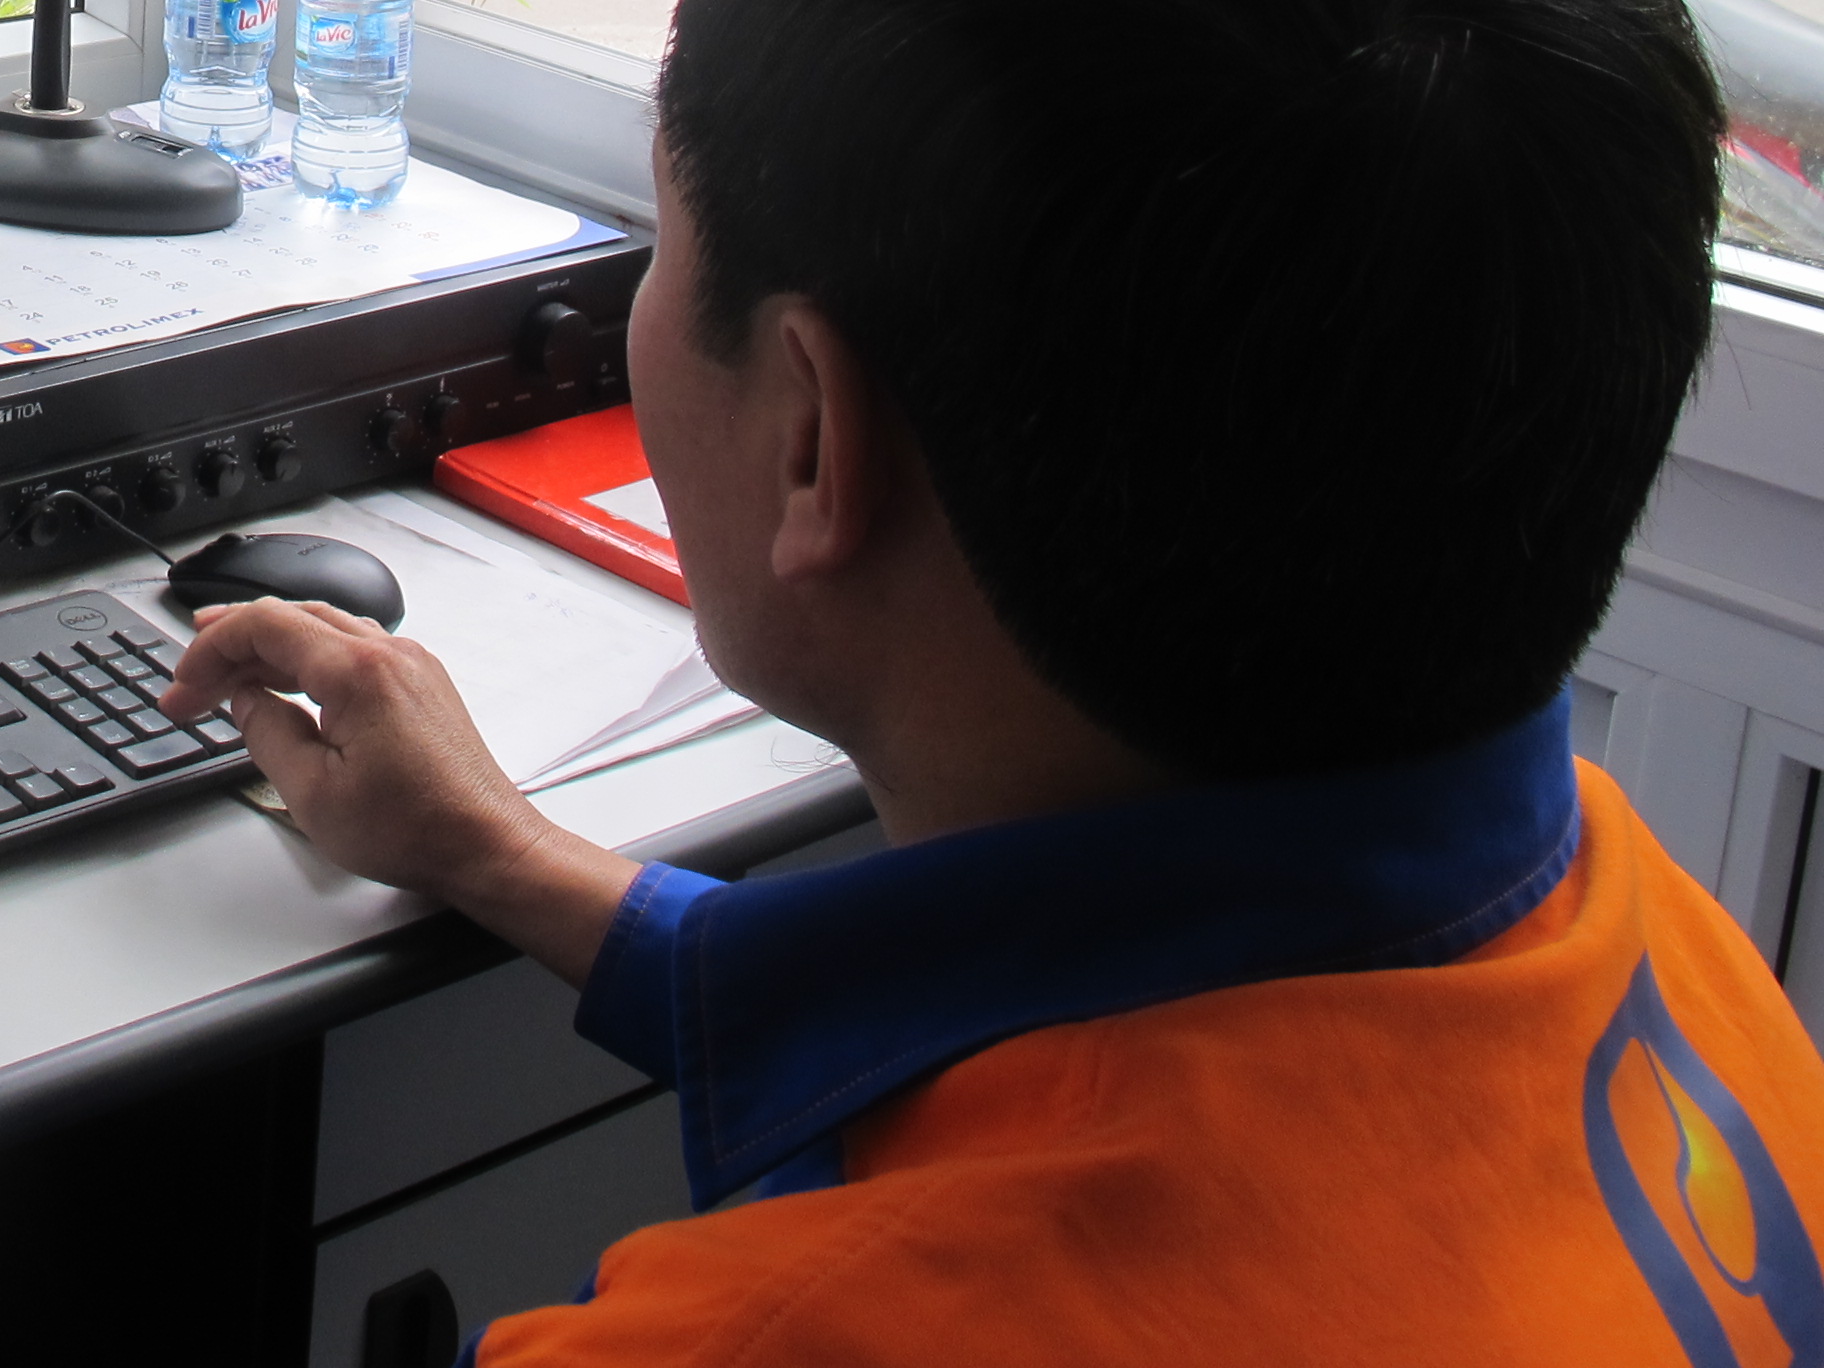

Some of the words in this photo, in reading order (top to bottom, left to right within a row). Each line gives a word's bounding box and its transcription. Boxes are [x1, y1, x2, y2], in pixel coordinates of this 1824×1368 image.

[19, 310, 44, 321] 24
[94, 296, 119, 307] 25
[45, 307, 205, 346] PETROLIMEX
[15, 401, 43, 419] TOA
[66, 612, 101, 626] DELL
